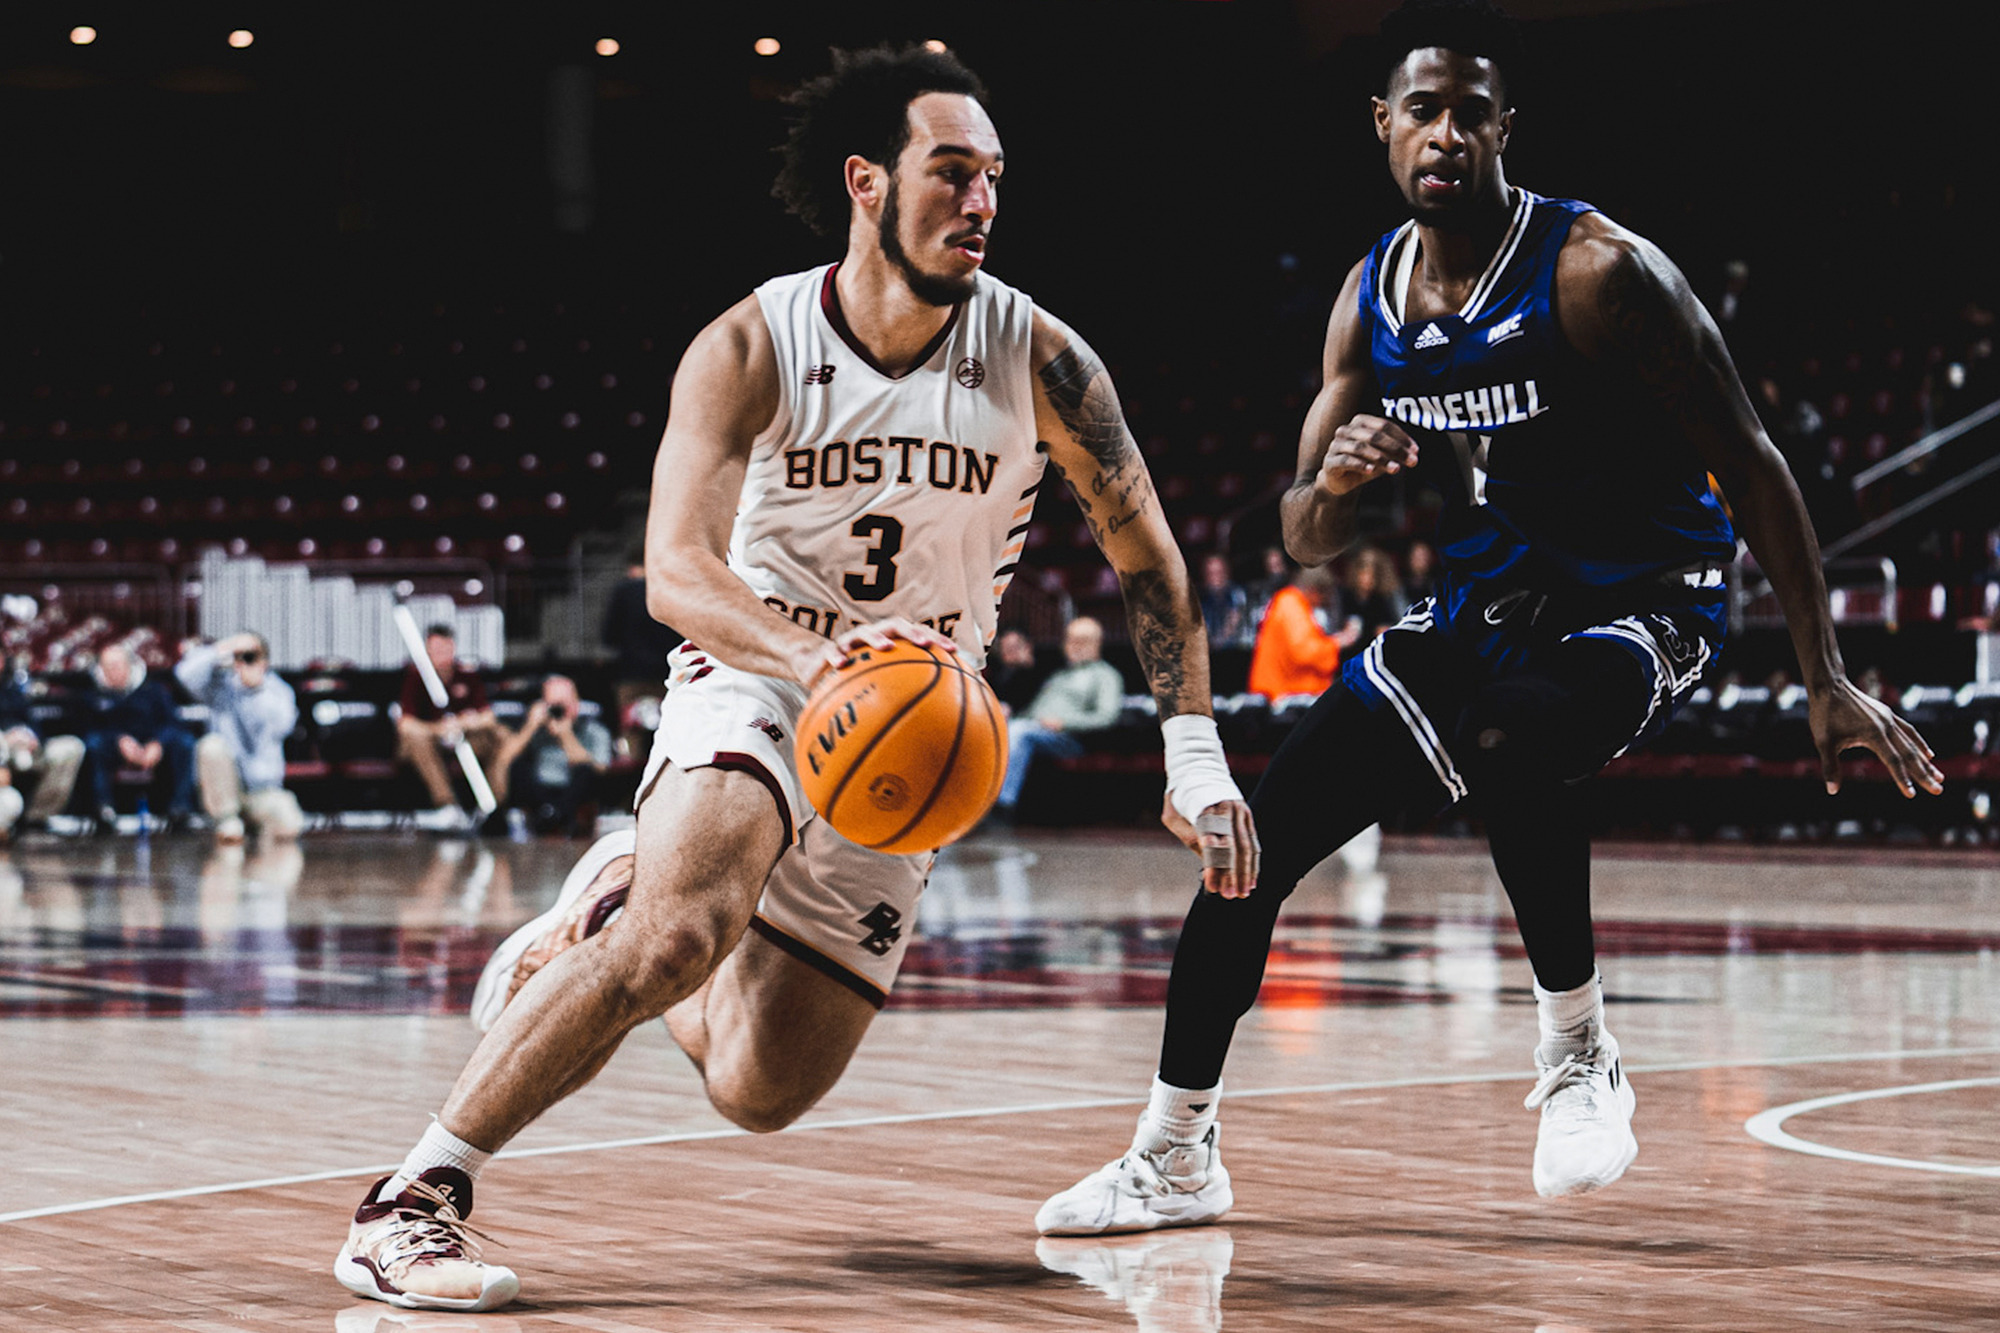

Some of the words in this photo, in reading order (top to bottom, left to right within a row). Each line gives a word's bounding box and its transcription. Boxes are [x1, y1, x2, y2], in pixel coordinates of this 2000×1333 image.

[1414, 336, 1450, 350] adidas
[1487, 313, 1522, 343] NEC
[1381, 380, 1549, 431] TONEHILL
[784, 436, 999, 494] BOSTON
[843, 514, 904, 602] 3
